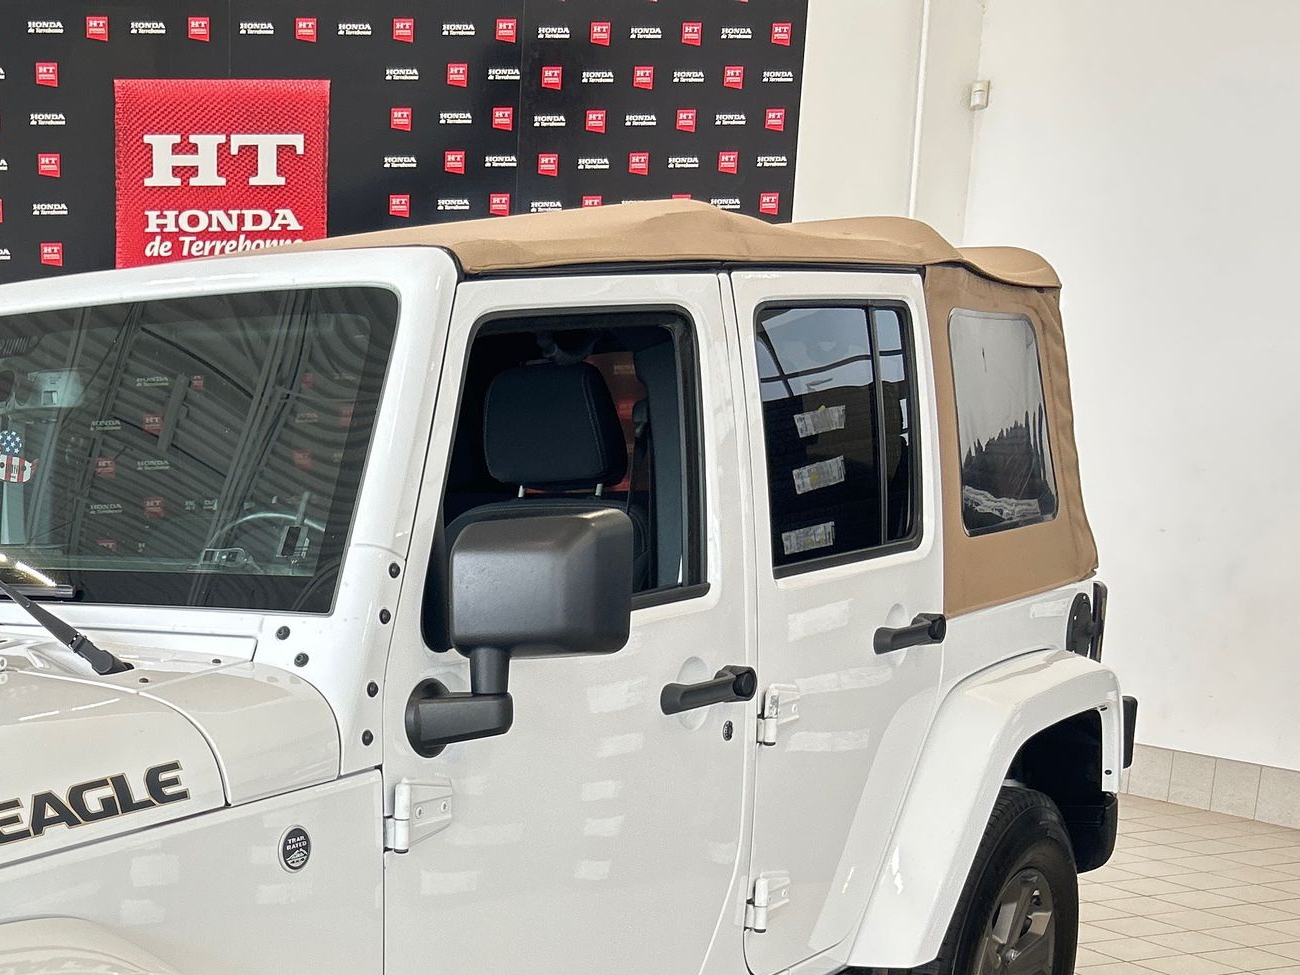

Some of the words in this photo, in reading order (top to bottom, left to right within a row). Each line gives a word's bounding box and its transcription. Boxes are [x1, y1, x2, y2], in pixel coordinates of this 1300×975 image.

[143, 134, 305, 187] HT
[144, 209, 304, 233] HONDA
[145, 236, 172, 257] de
[179, 234, 303, 256] Terrebo
[286, 841, 307, 851] RATED
[288, 835, 306, 845] TRAIL
